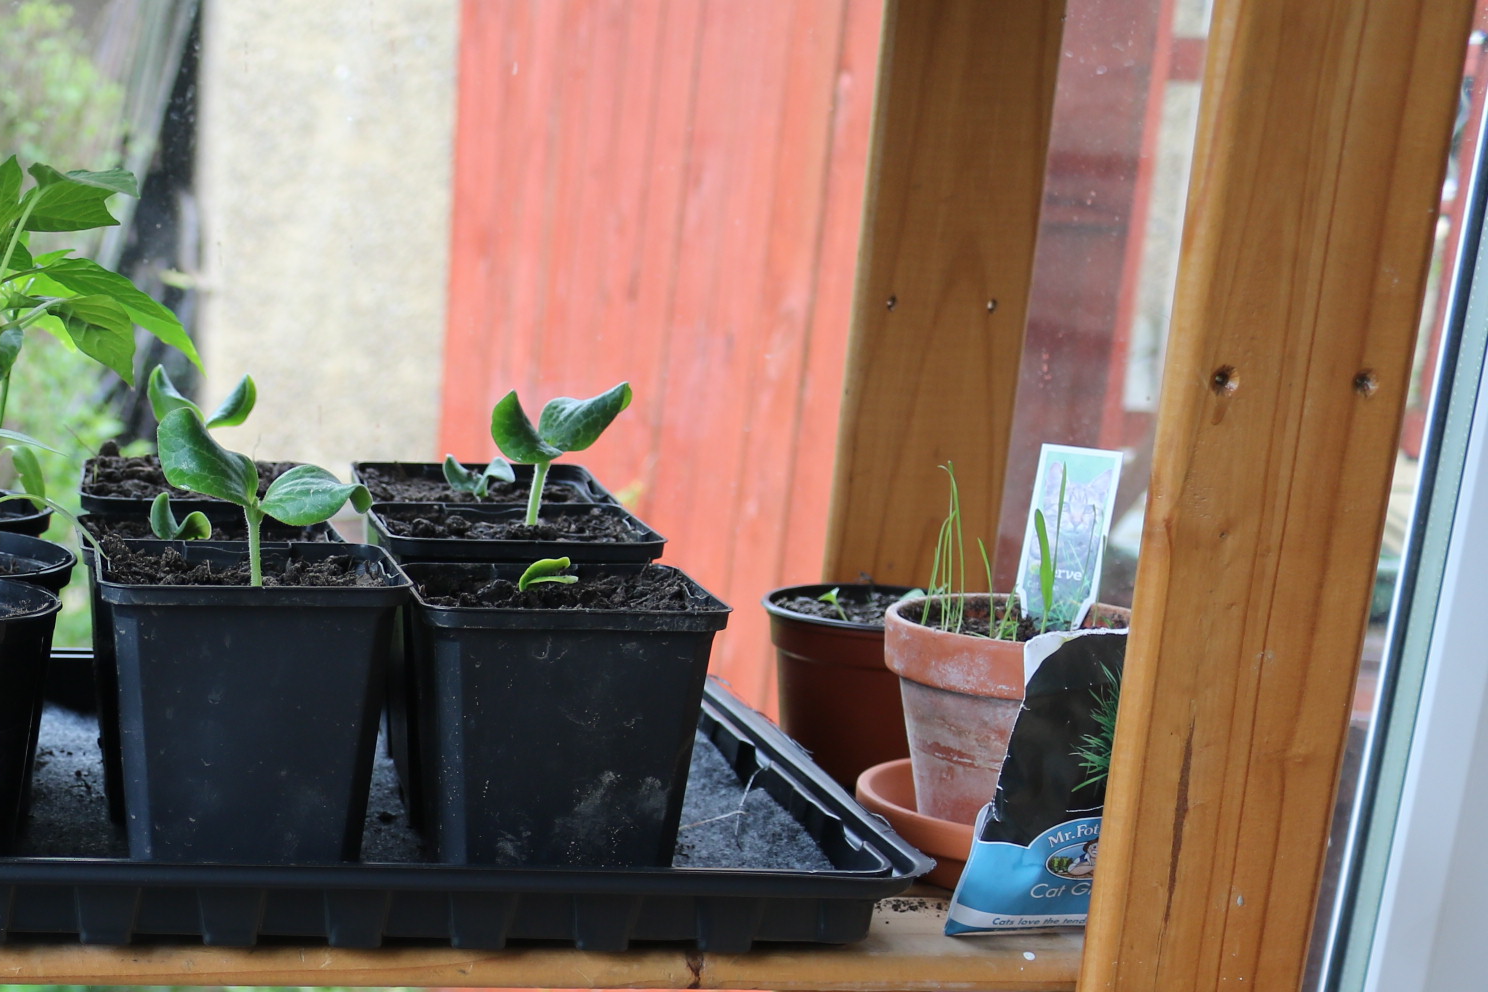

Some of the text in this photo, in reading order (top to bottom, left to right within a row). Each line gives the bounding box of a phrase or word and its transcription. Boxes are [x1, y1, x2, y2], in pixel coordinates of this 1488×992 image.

[1030, 883, 1066, 899] Cat
[992, 917, 1015, 926] Cats
[1017, 917, 1040, 926] love
[1042, 917, 1060, 925] the
